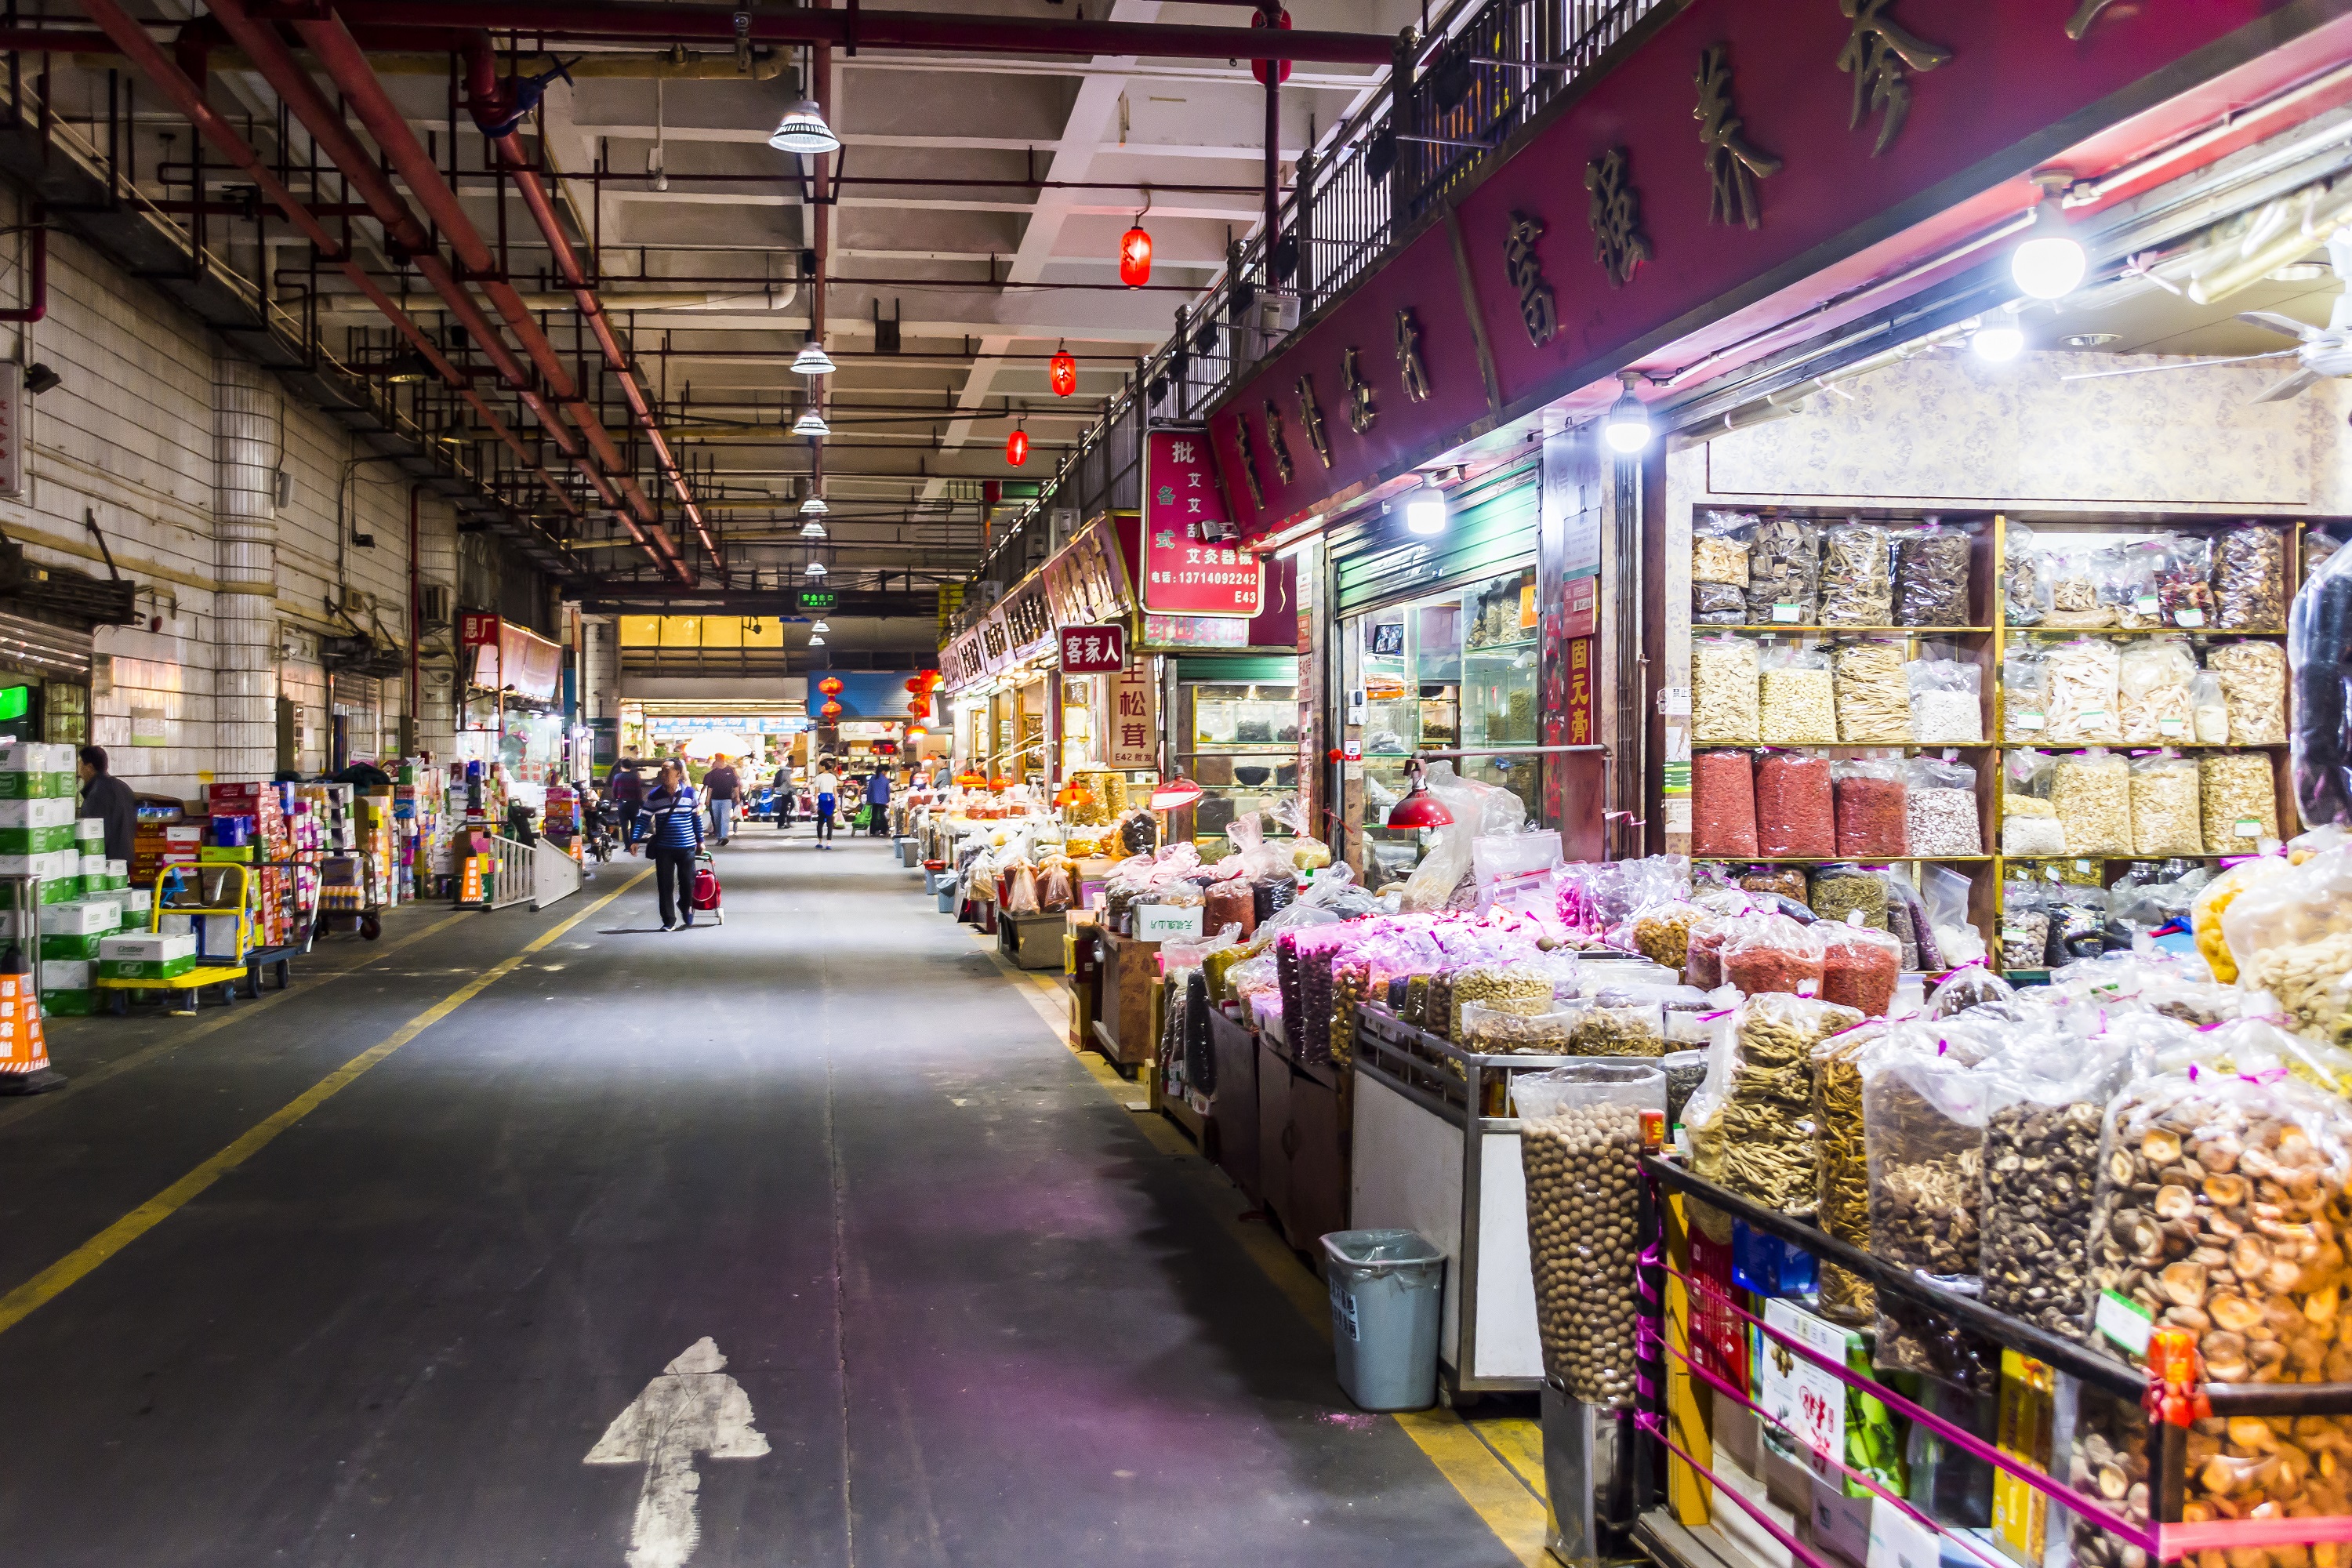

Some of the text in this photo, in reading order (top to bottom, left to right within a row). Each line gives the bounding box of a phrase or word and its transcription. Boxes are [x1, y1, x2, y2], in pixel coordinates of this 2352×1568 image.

[1171, 441, 1196, 464] 批
[1186, 548, 1254, 565] 艾灸器械
[1234, 590, 1257, 604] E43
[1066, 635, 1120, 665] 客家人
[1570, 637, 1589, 744] 固元膏
[1115, 753, 1132, 761] E42
